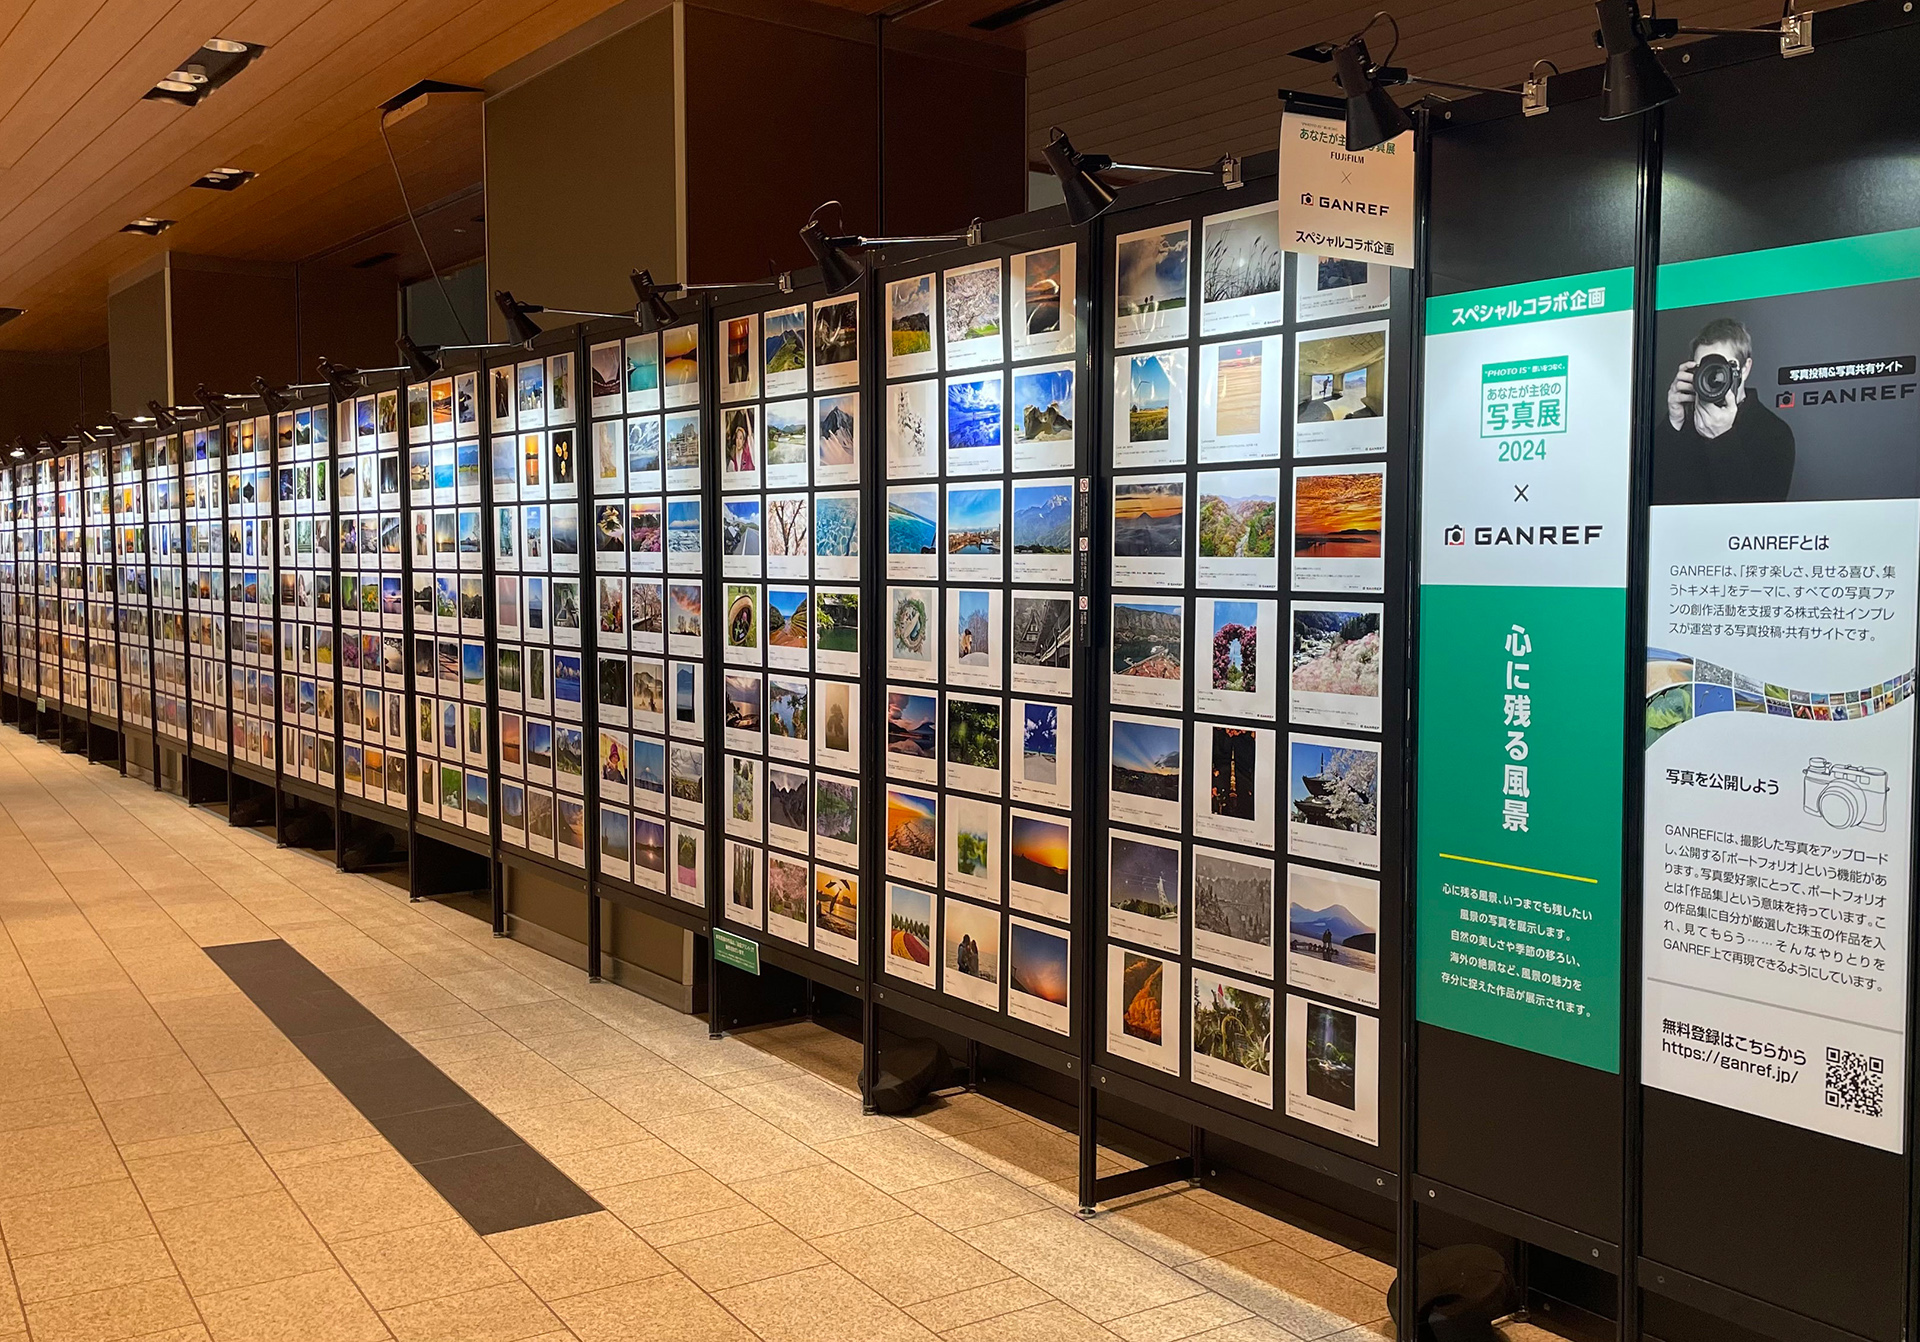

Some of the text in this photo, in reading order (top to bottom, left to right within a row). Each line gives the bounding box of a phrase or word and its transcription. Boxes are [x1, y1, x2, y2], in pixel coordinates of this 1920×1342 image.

[1319, 196, 1390, 216] GANREF
[1296, 230, 1395, 256] スペシャルコラボ企画
[1451, 287, 1606, 327] スペシャルコラボ企画
[1487, 382, 1562, 401] あなたが主役の
[1803, 383, 1917, 406] GANREF
[1487, 399, 1561, 431] 写真展
[1498, 438, 1547, 462] 2024
[1474, 525, 1603, 545] GANREF
[1728, 535, 1830, 551] GANREFとは
[1502, 623, 1532, 832] 心に残る風景
[1666, 768, 1780, 795] 写真を公開しよう
[1442, 882, 1593, 921] 心に残る風景、いつまでも残したい
[1459, 908, 1571, 942] 風景の写真を展示します。
[1662, 1018, 1807, 1065] 無料登録はこちらから
[1662, 1038, 1798, 1084] https://ganref.jp/
